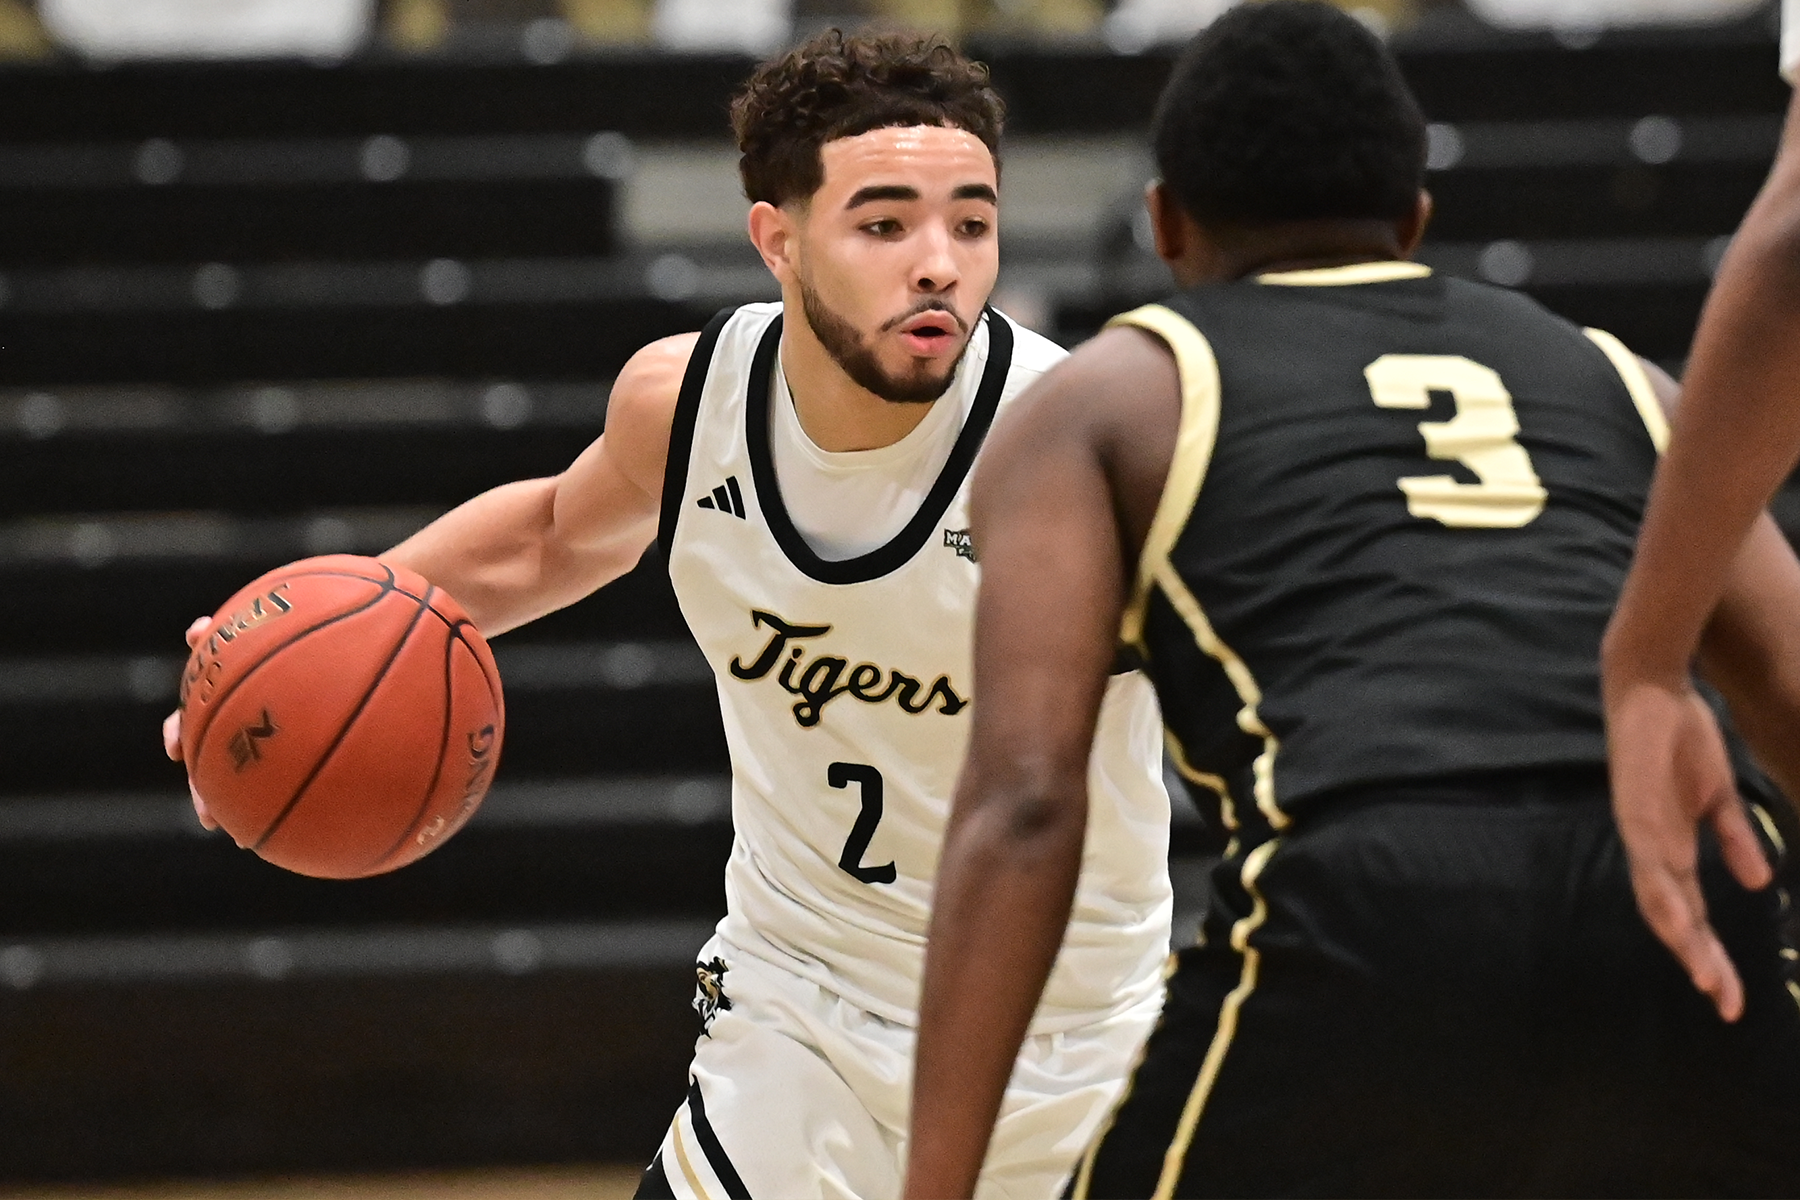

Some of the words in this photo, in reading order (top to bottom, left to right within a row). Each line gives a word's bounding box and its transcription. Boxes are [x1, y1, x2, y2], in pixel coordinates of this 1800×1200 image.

[1363, 353, 1550, 529] 3
[728, 608, 969, 729] Tigers
[827, 761, 897, 884] 2
